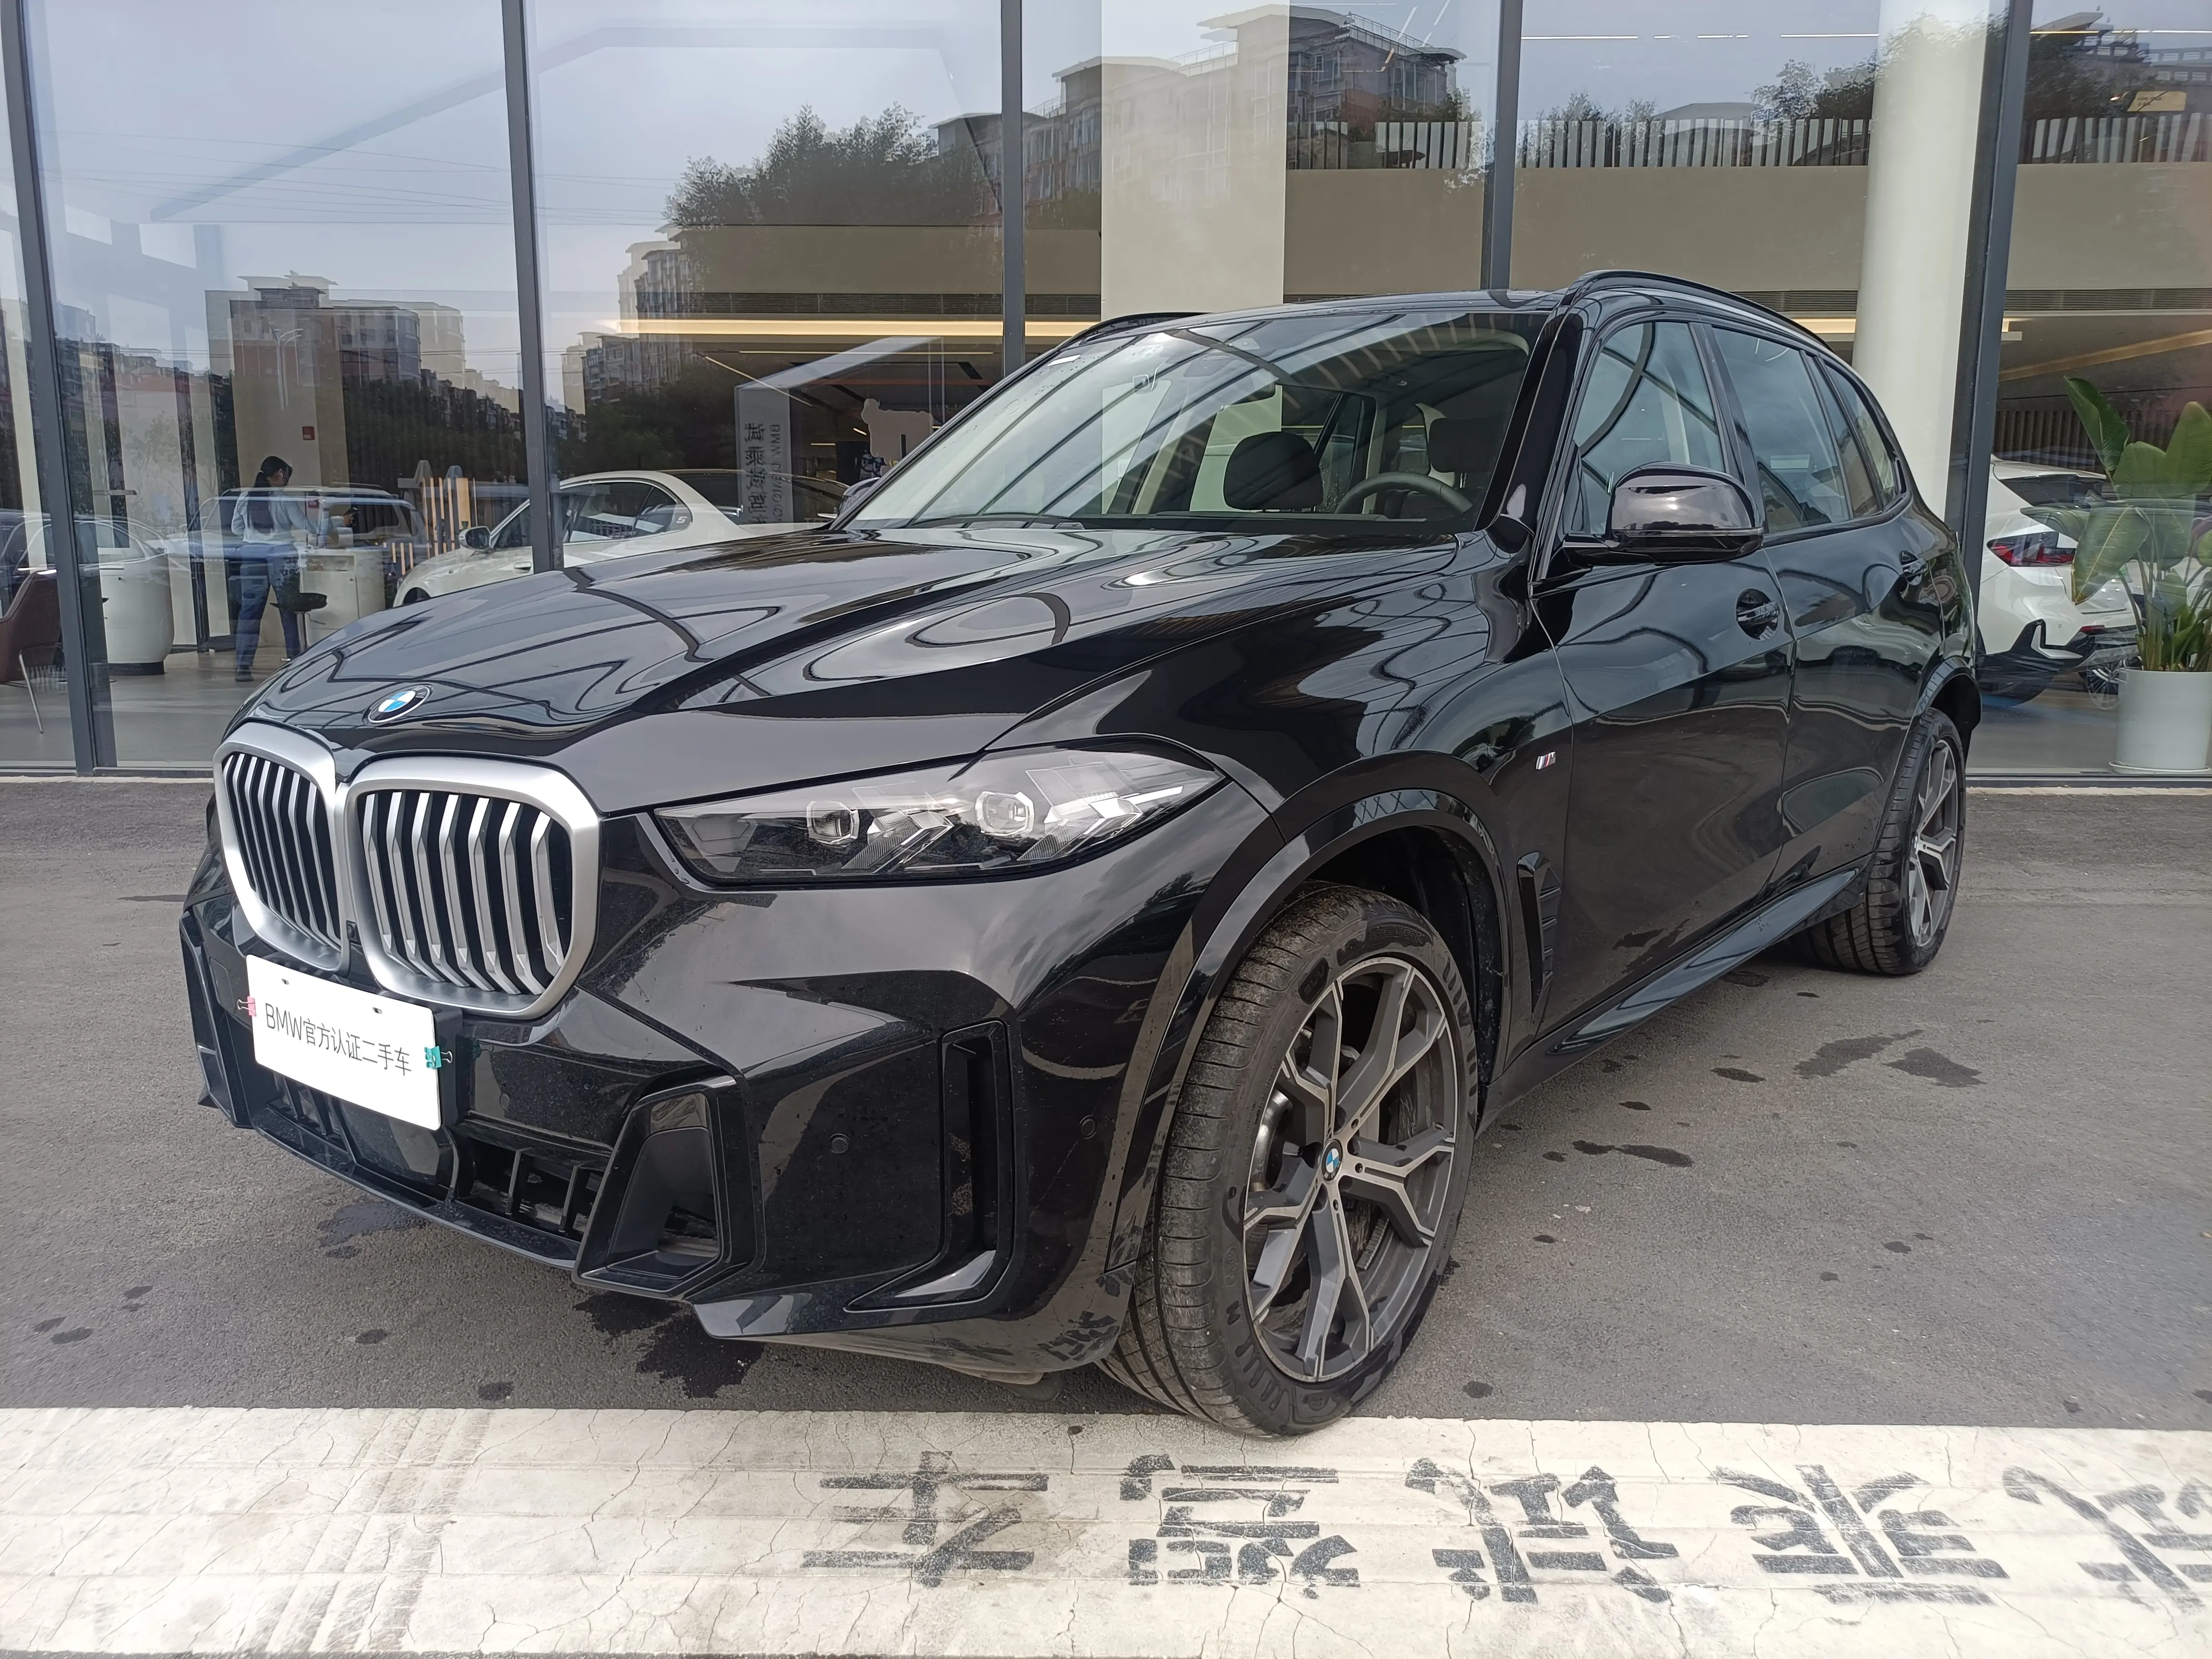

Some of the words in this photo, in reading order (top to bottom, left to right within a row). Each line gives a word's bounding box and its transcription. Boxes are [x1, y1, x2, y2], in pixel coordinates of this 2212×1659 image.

[265, 1003, 411, 1076] BMW官方认证二手车
